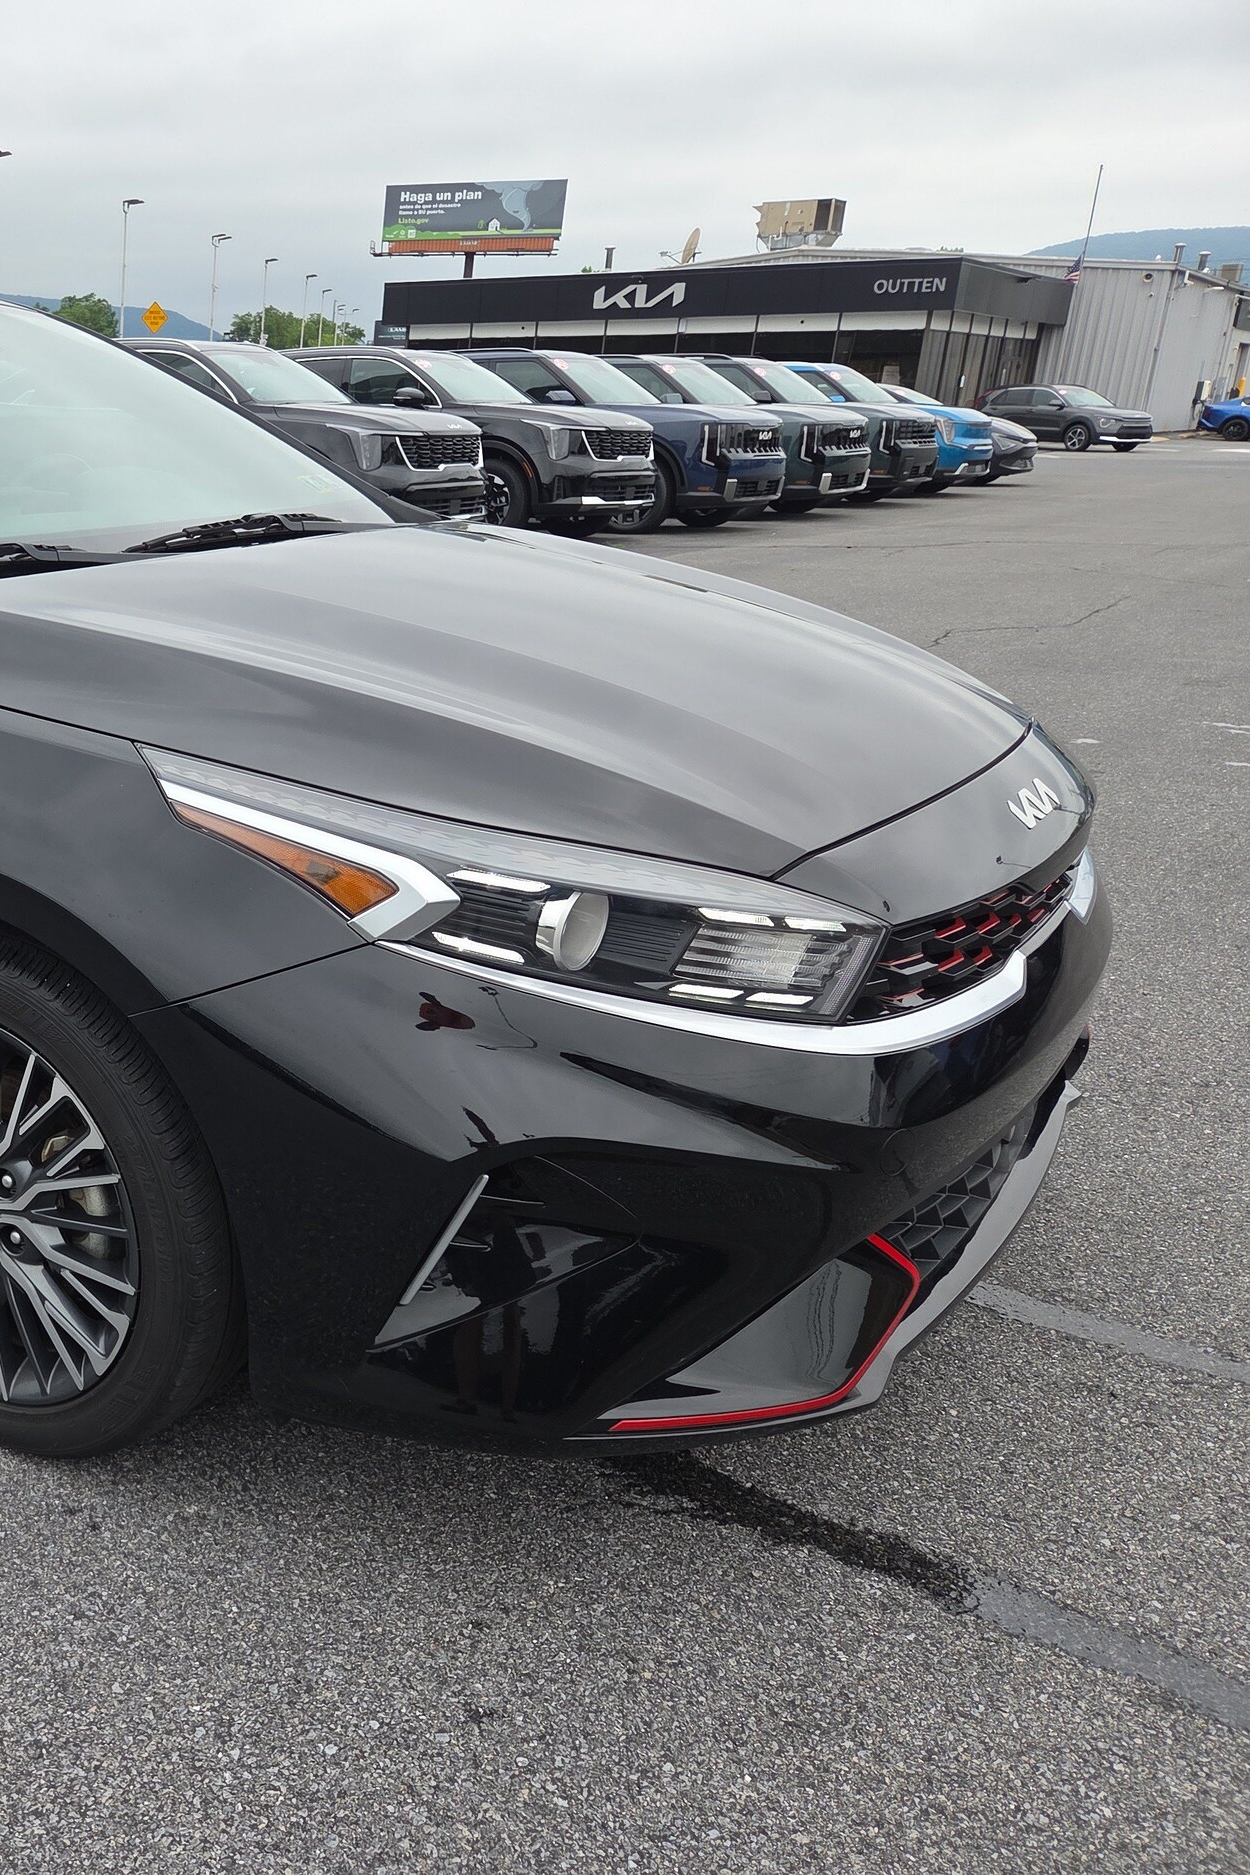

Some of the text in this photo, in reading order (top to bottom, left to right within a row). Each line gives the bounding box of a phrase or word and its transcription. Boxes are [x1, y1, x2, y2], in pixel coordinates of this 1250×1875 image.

[400, 189, 482, 204] Haga un plan
[398, 217, 429, 225] Listo.gov
[873, 277, 947, 294] OUTTEN
[593, 282, 686, 309] KIA
[758, 431, 772, 440] KIA
[1007, 778, 1060, 829] KIA
